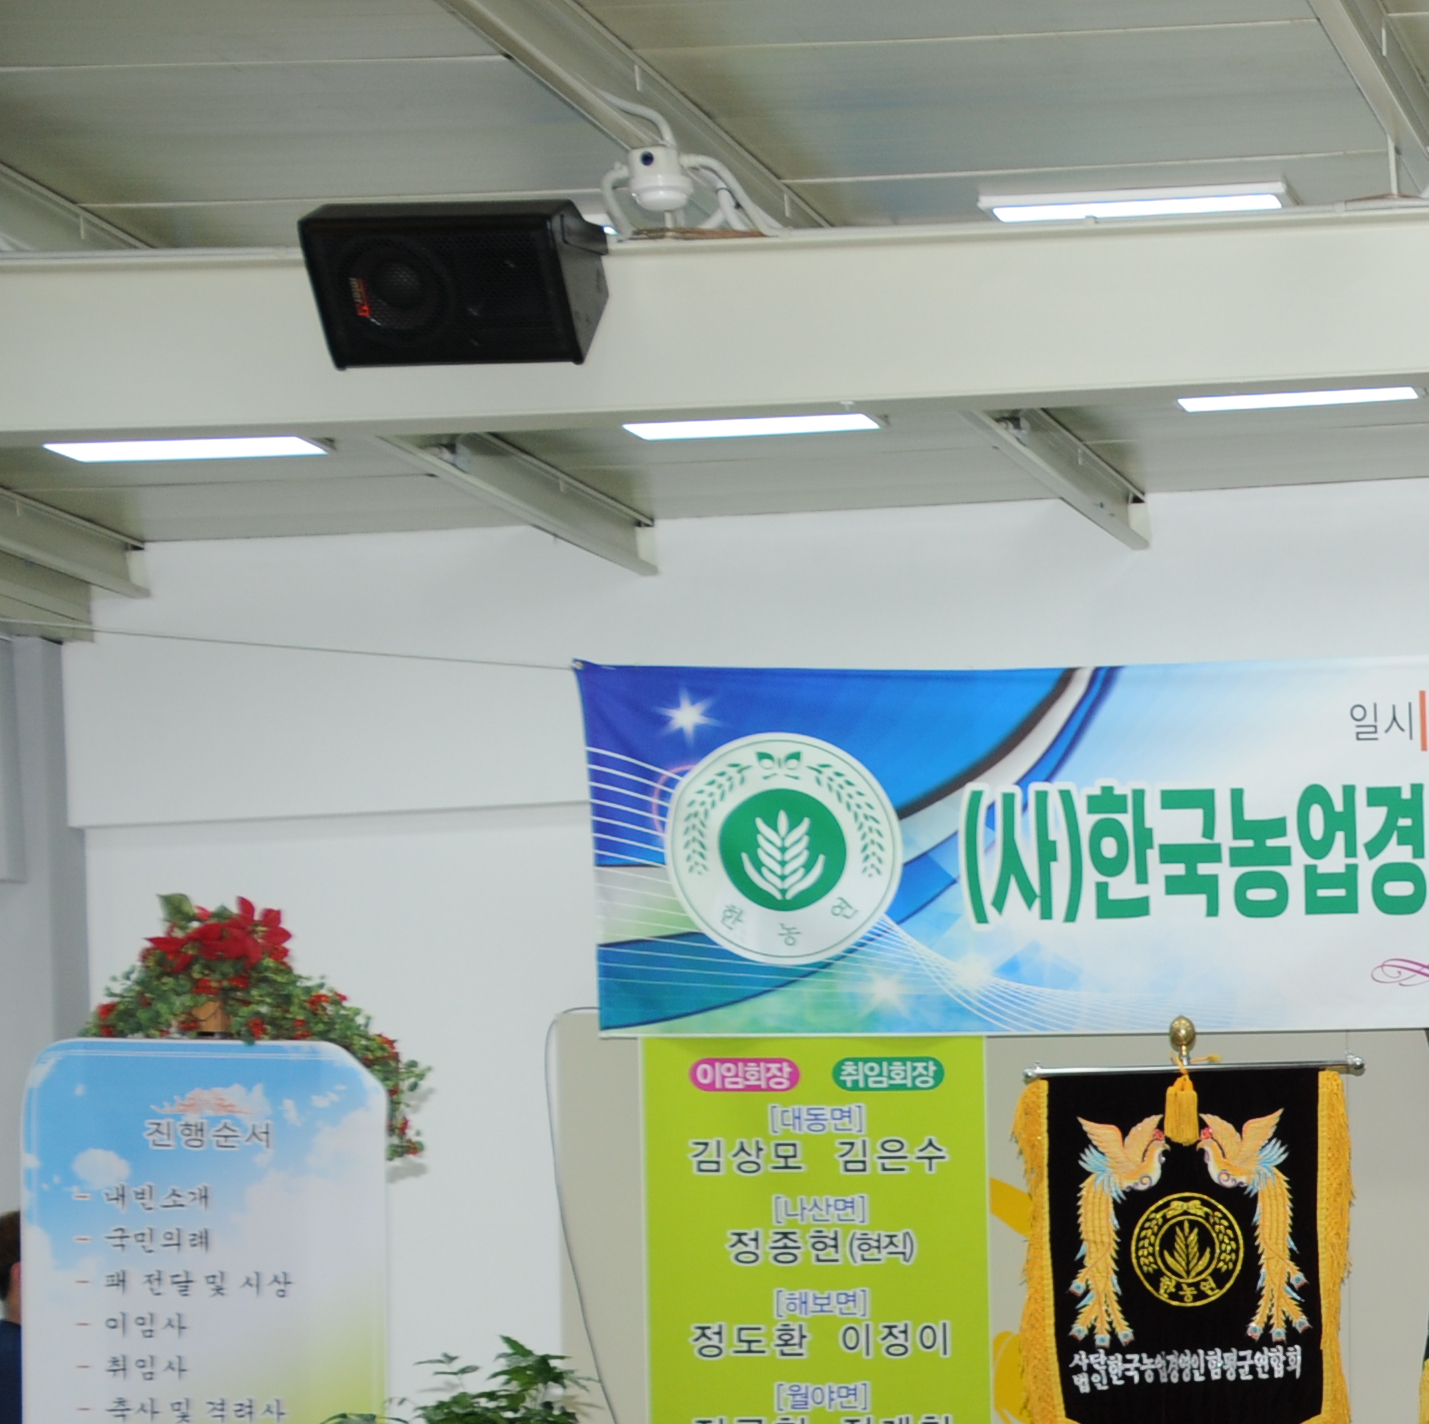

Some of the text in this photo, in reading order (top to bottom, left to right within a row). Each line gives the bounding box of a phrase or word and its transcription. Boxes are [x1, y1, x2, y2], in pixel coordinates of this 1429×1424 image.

[1349, 700, 1415, 742] 일시
[695, 1060, 936, 1089] 이임회장 취임회장
[144, 1119, 273, 1150] 진행순서
[691, 1137, 947, 1174] 김상모 김은수
[104, 1184, 211, 1212] 내빈소개
[104, 1227, 211, 1254] 국민의례
[104, 1271, 293, 1299] 패 전달 및 시상
[104, 1313, 189, 1338] 이임사
[691, 1321, 951, 1359] 정도환 이정이
[104, 1356, 189, 1381] 취임사
[105, 1399, 287, 1424] 축사 및 격려사
